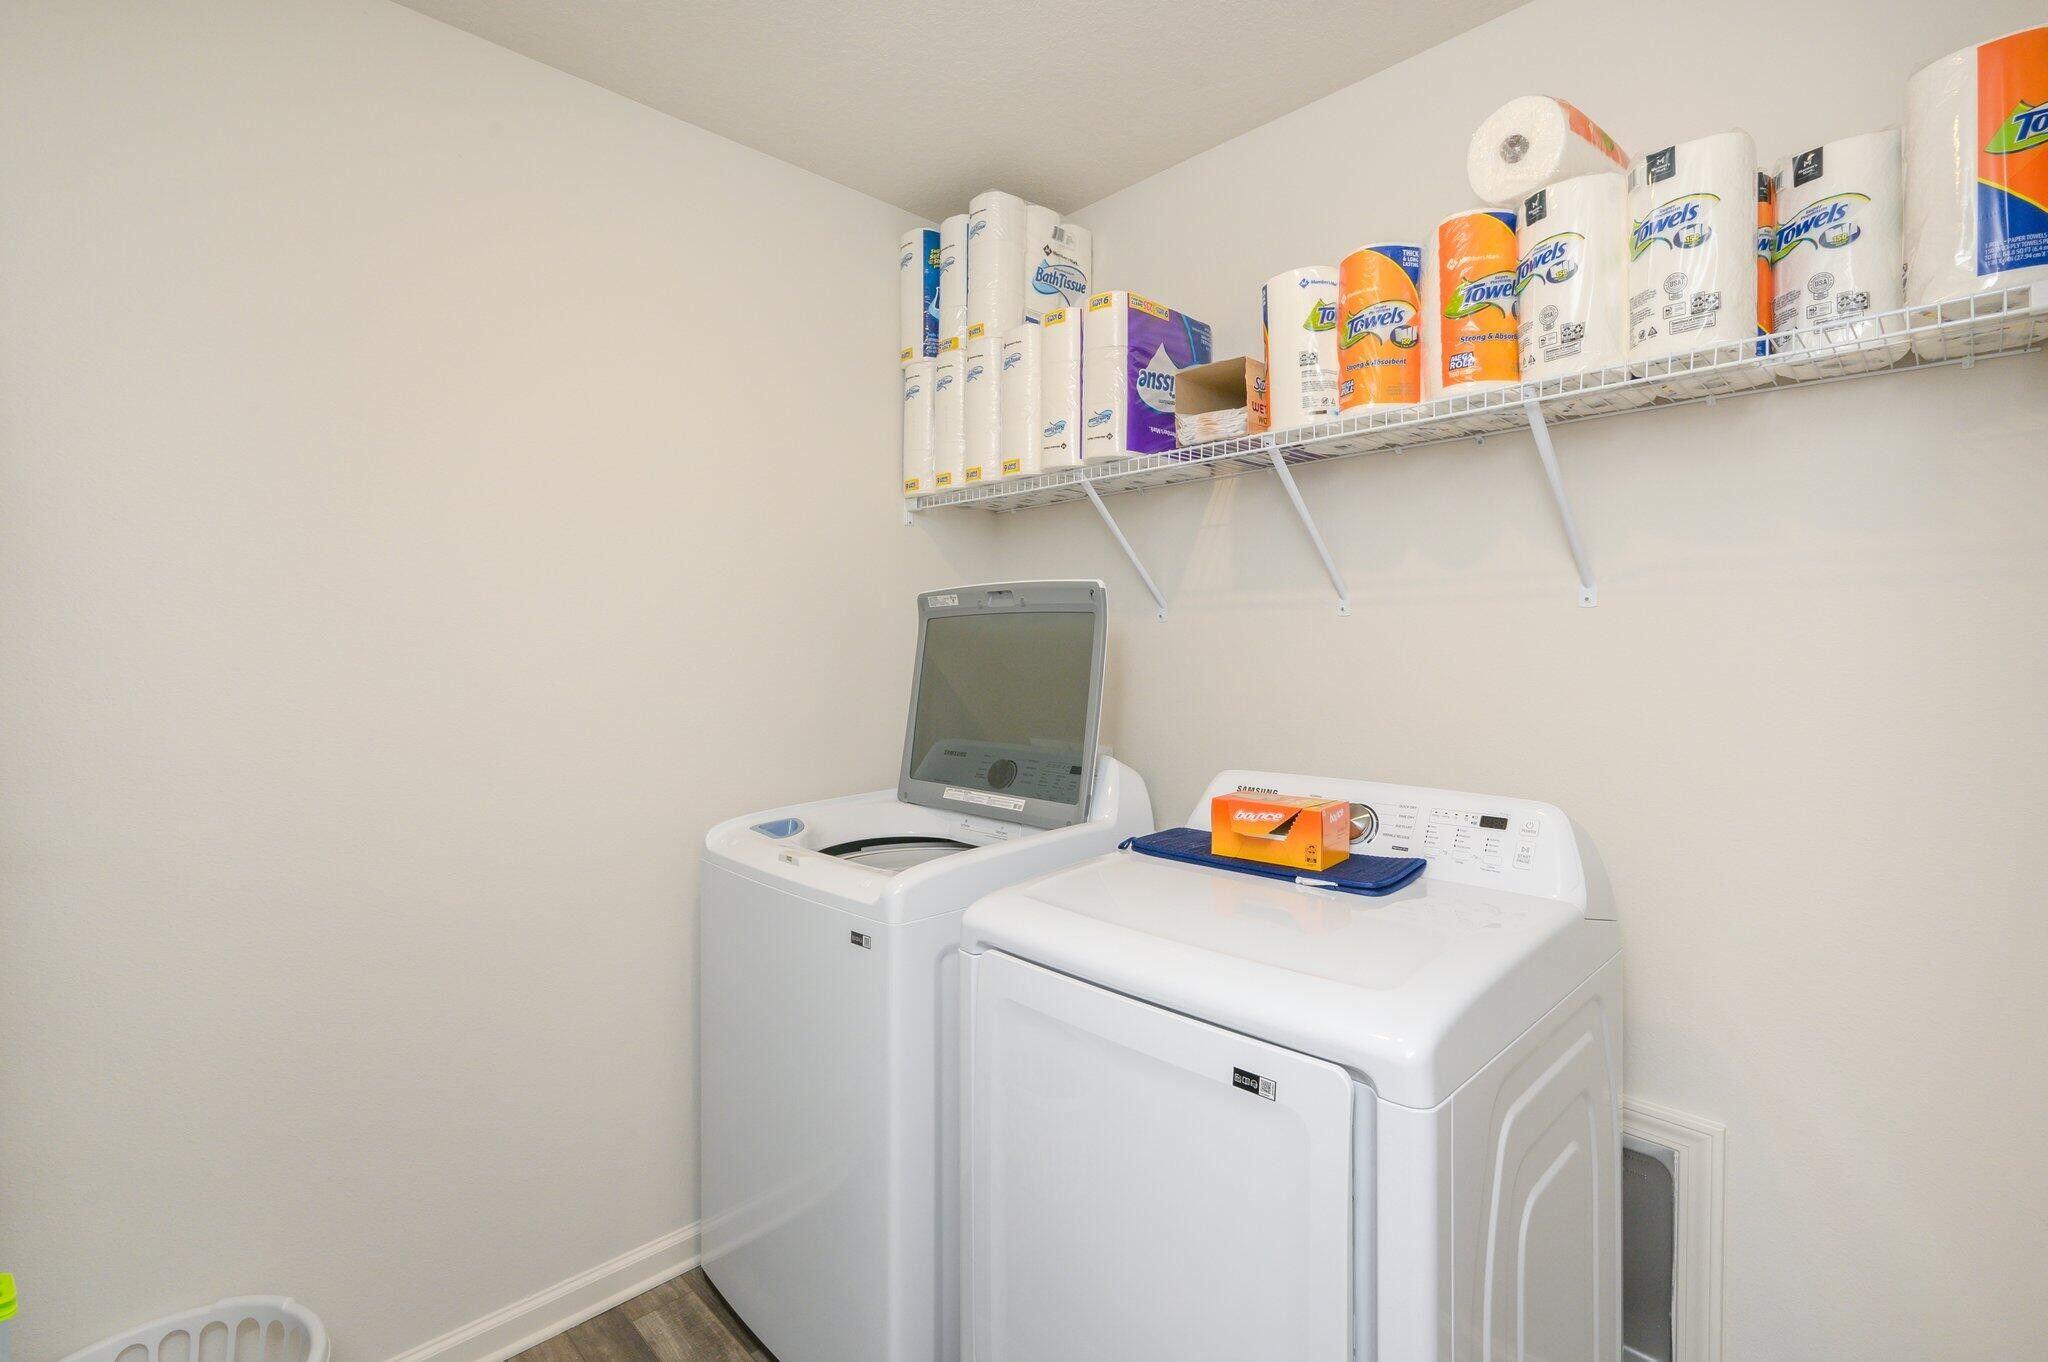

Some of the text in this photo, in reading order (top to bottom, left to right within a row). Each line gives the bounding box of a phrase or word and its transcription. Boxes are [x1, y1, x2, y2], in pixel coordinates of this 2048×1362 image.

[1633, 202, 1700, 251] Towels
[1775, 202, 1849, 252] Towels
[1402, 249, 1419, 257] THICK
[1516, 241, 1568, 284] Towels
[1034, 265, 1087, 294] BathTissue
[1347, 306, 1405, 340] Towels
[1460, 333, 1486, 343] Strong
[1236, 785, 1279, 795] SAMSUNG
[1234, 810, 1284, 822] bounce
